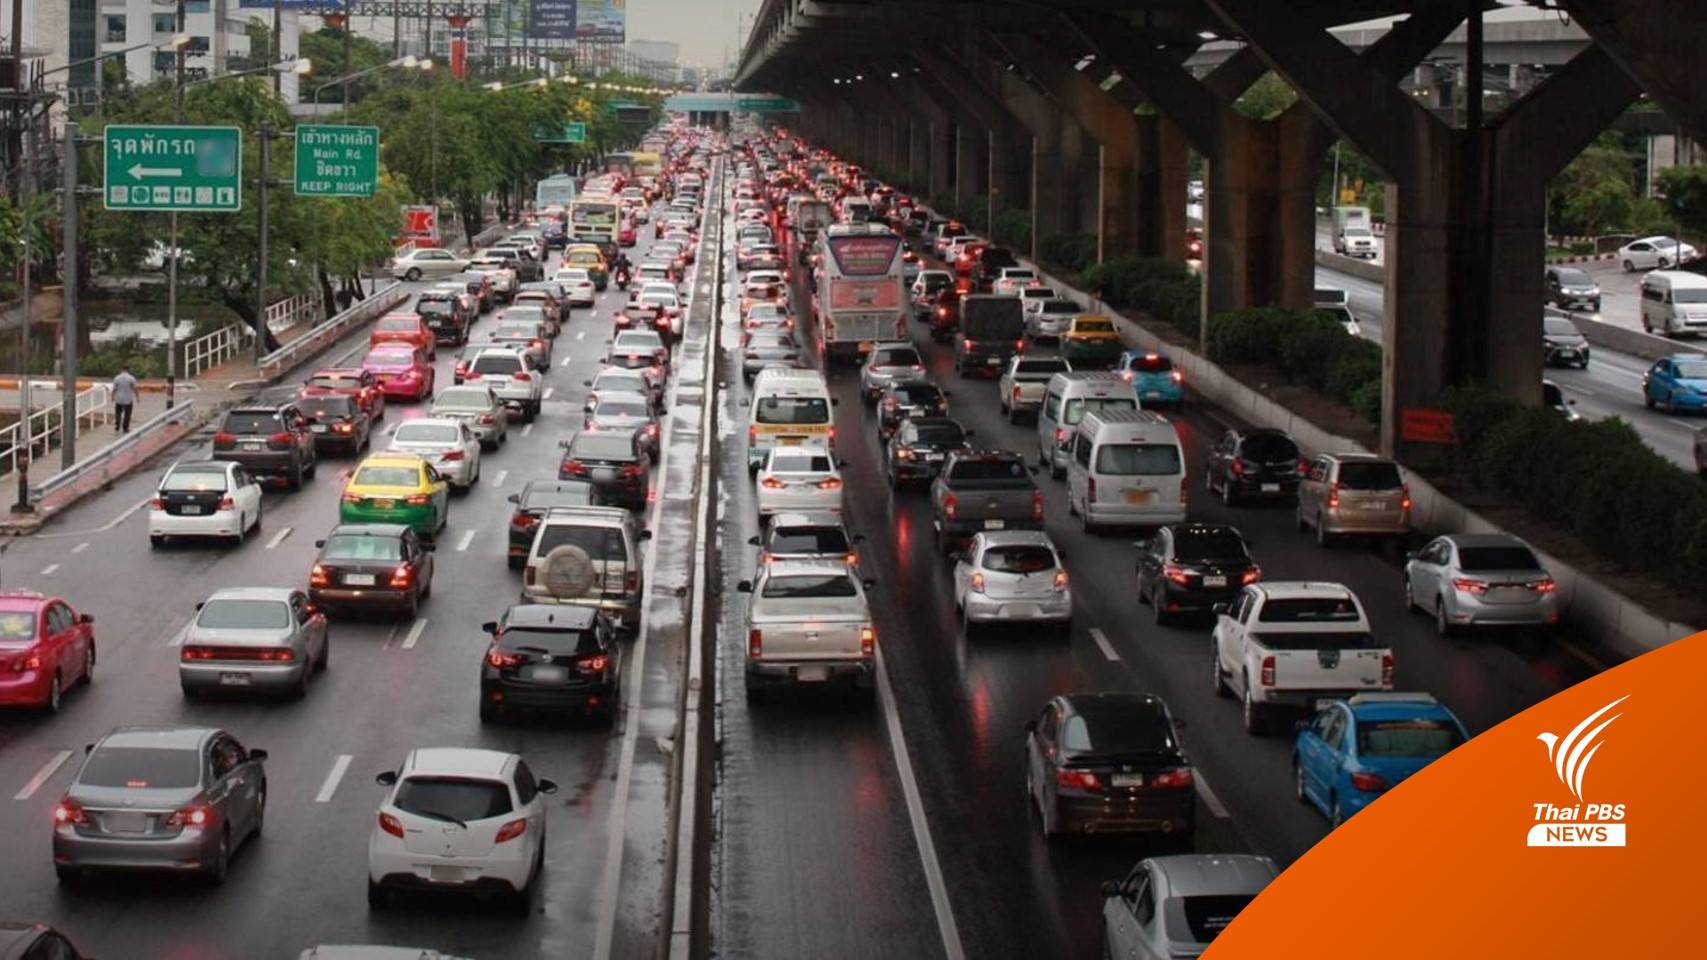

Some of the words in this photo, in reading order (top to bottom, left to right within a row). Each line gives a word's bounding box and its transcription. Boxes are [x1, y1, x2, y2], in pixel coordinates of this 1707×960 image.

[302, 128, 374, 145] เข้าทางหลัก
[111, 133, 195, 160] จุดพักรถ
[313, 148, 339, 159] Main
[316, 160, 356, 177] ชิดขวา
[301, 181, 331, 192] KEEP
[336, 182, 371, 193] RIGHT
